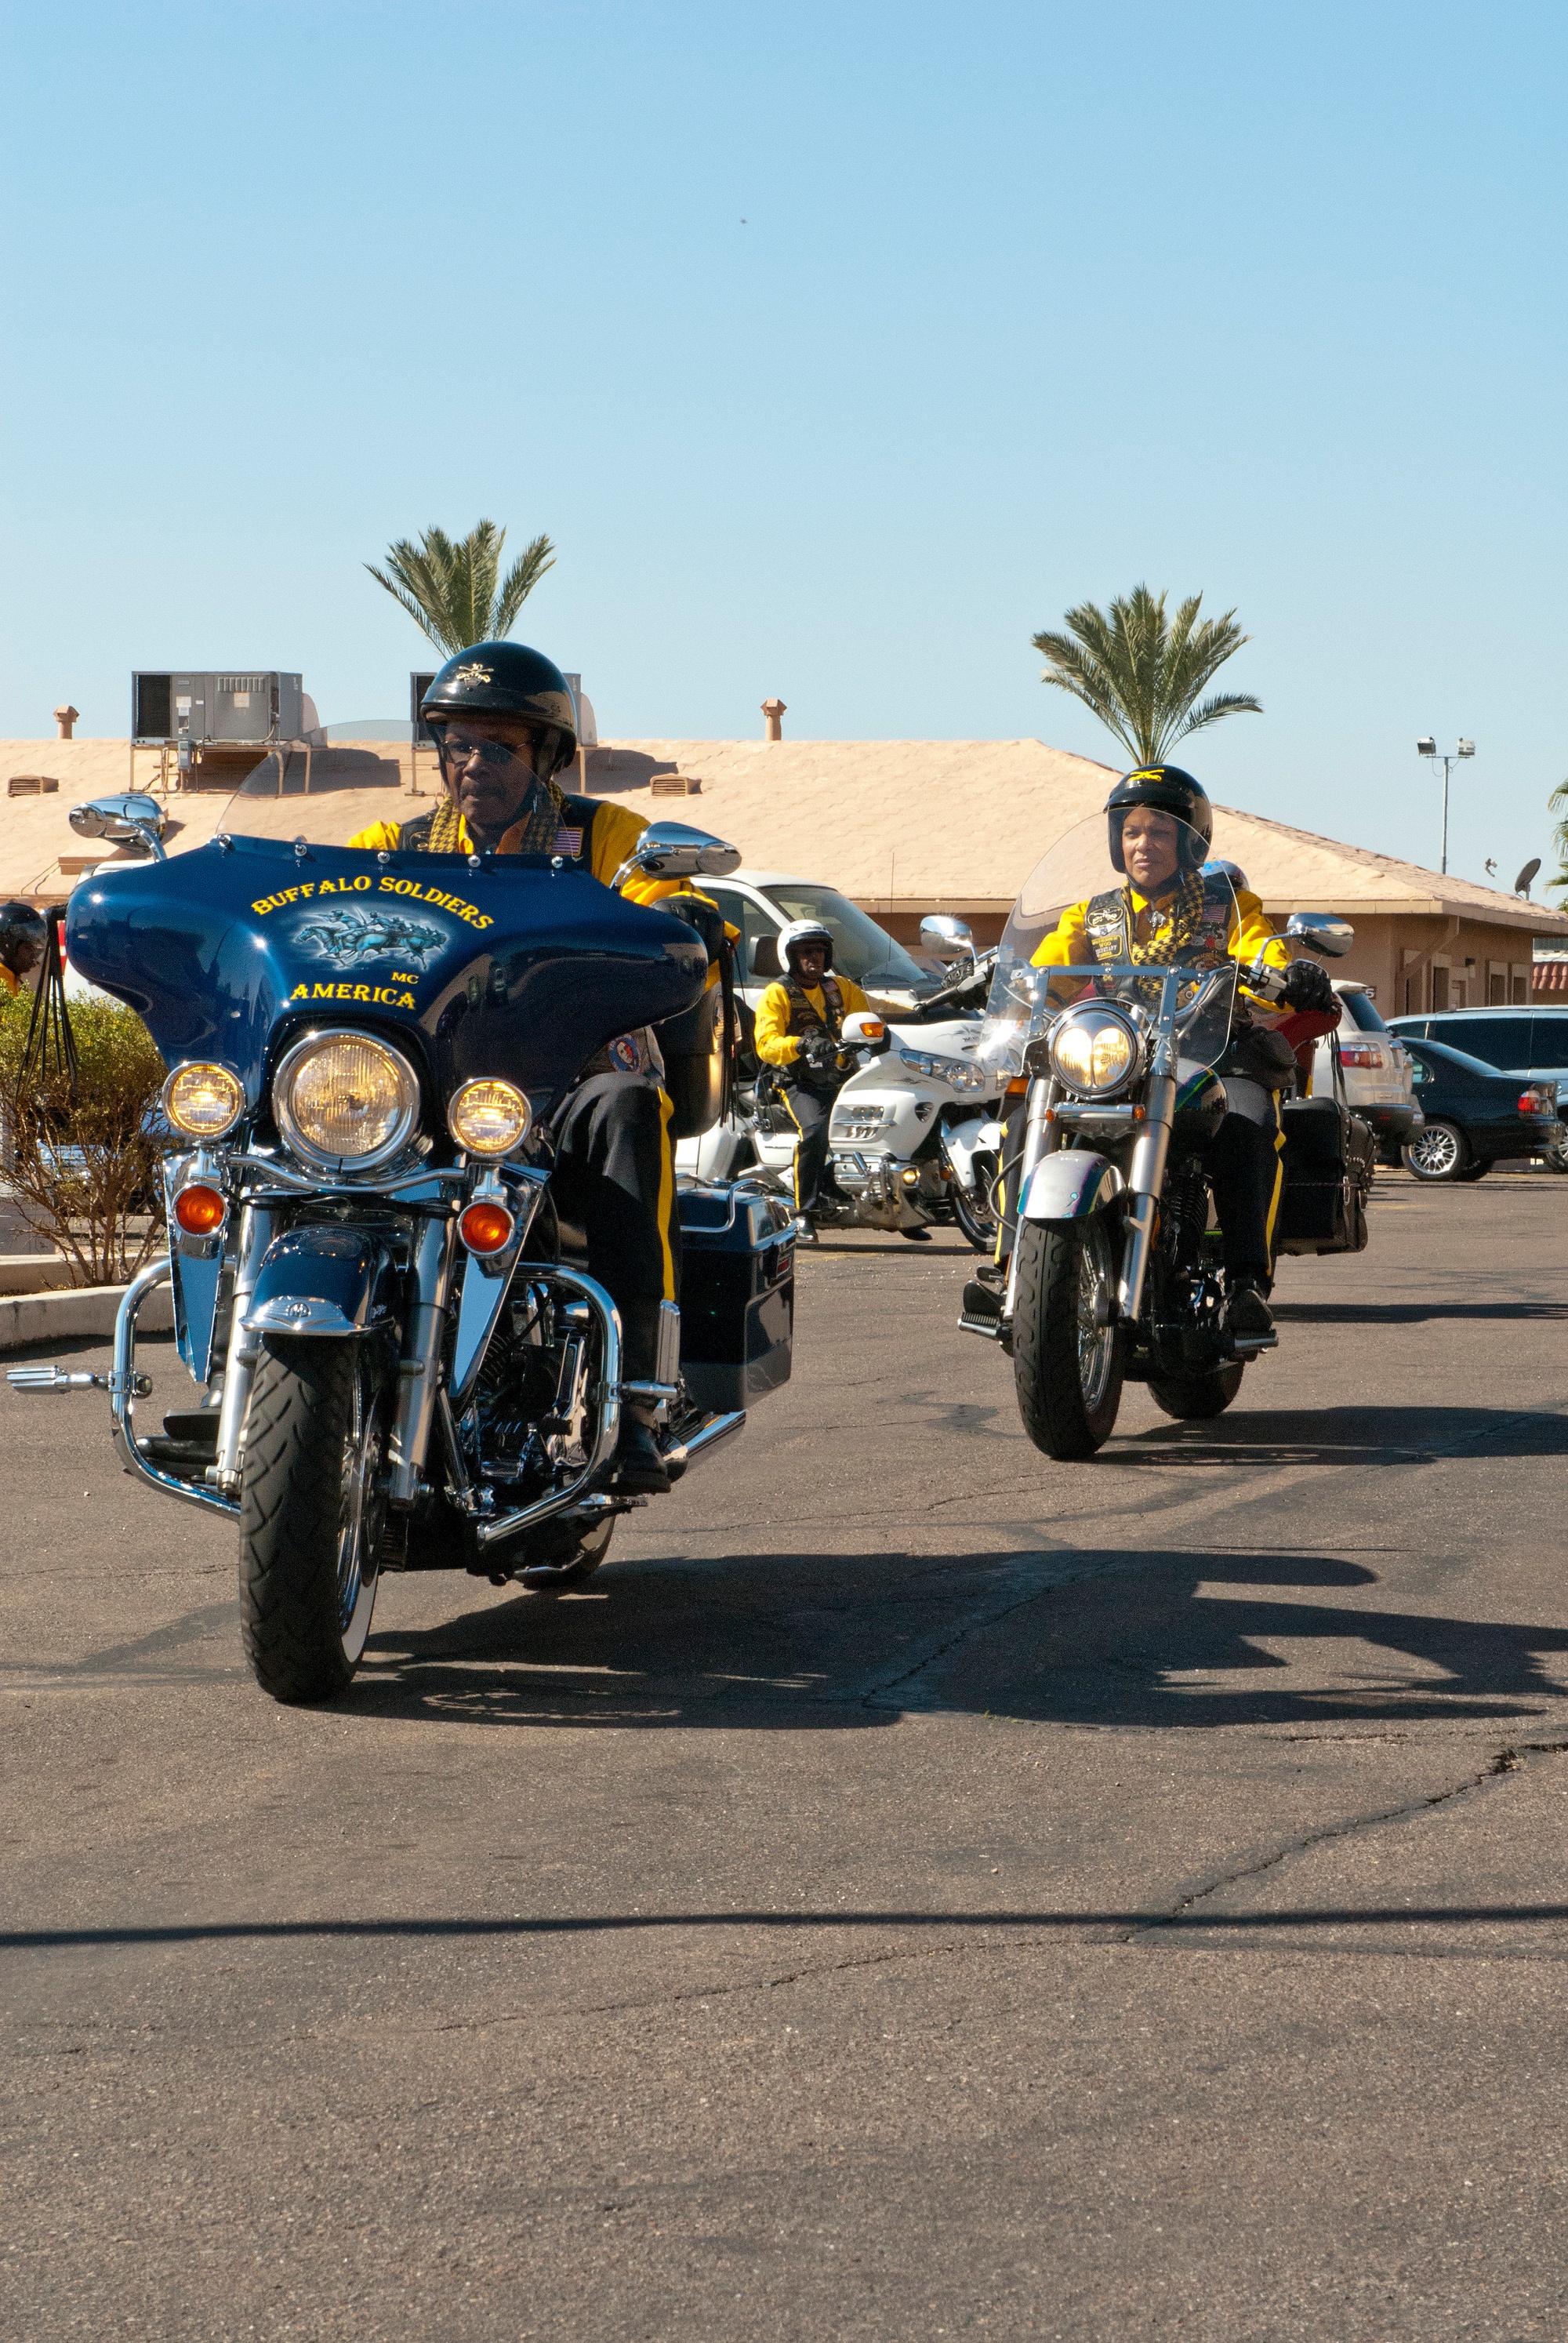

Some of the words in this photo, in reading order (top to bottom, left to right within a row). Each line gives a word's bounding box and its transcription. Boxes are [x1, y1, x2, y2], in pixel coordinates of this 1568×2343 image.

[251, 875, 372, 916] BUFFALO
[378, 877, 495, 930] SOLDIERS
[391, 972, 419, 985] MC
[290, 983, 416, 1010] AMERICA
